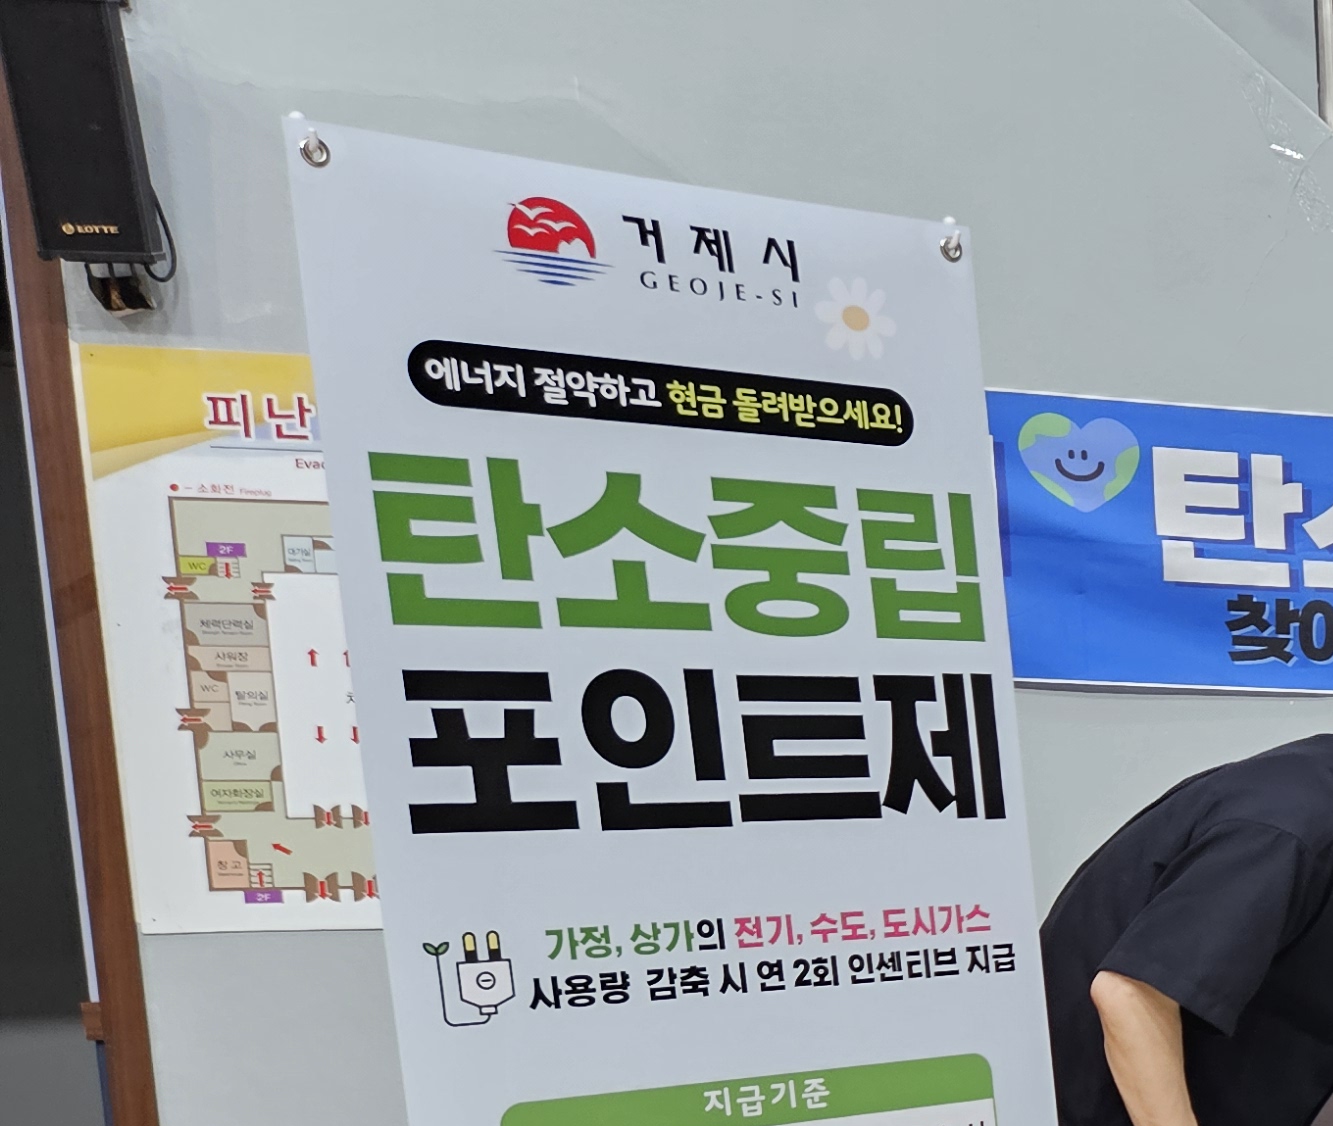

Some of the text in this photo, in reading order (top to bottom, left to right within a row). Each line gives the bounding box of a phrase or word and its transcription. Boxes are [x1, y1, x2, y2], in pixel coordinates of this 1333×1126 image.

[76, 224, 120, 234] LOTTE
[622, 214, 800, 283] 거제시
[639, 270, 799, 309] GEOJE-SI
[425, 357, 904, 436] 에너지 절약하고 현금 돌려받으세요!
[188, 562, 207, 571] WC
[367, 451, 986, 642] 탄소중립
[402, 668, 1006, 834] 포인트제
[545, 903, 992, 962] 가정, 상가의 전기, 수도, 도시가스
[528, 942, 1017, 1011] 사용량 감축 시 연 2회 인센티브 지급
[703, 1077, 831, 1118] 지급기준
